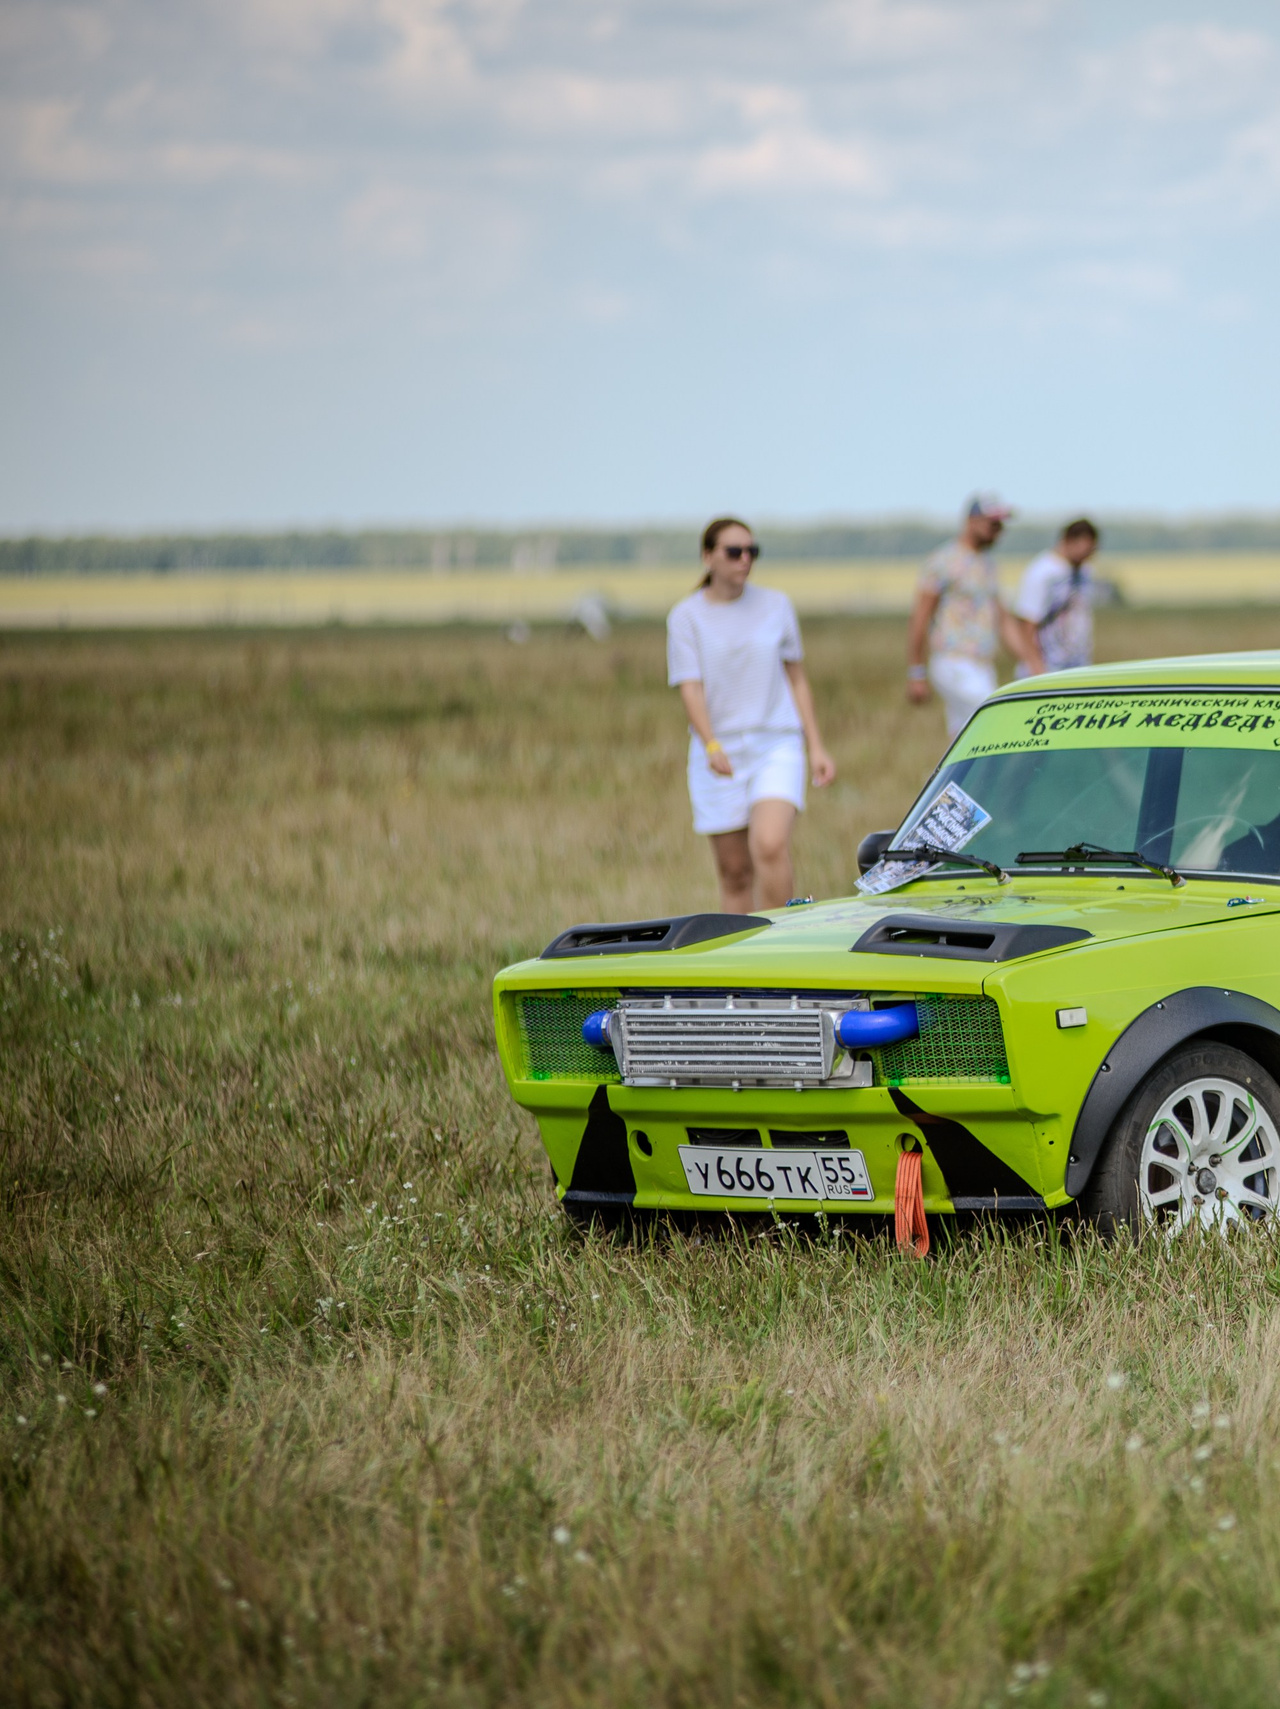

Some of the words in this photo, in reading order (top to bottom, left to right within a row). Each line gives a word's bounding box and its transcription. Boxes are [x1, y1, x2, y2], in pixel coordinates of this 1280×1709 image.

[967, 738, 1050, 757] Марьяновка
[931, 806, 968, 838] УЧАСТНИК
[695, 1156, 819, 1194] У666ТК
[821, 1157, 855, 1184] 55
[827, 1184, 851, 1195] RUS
